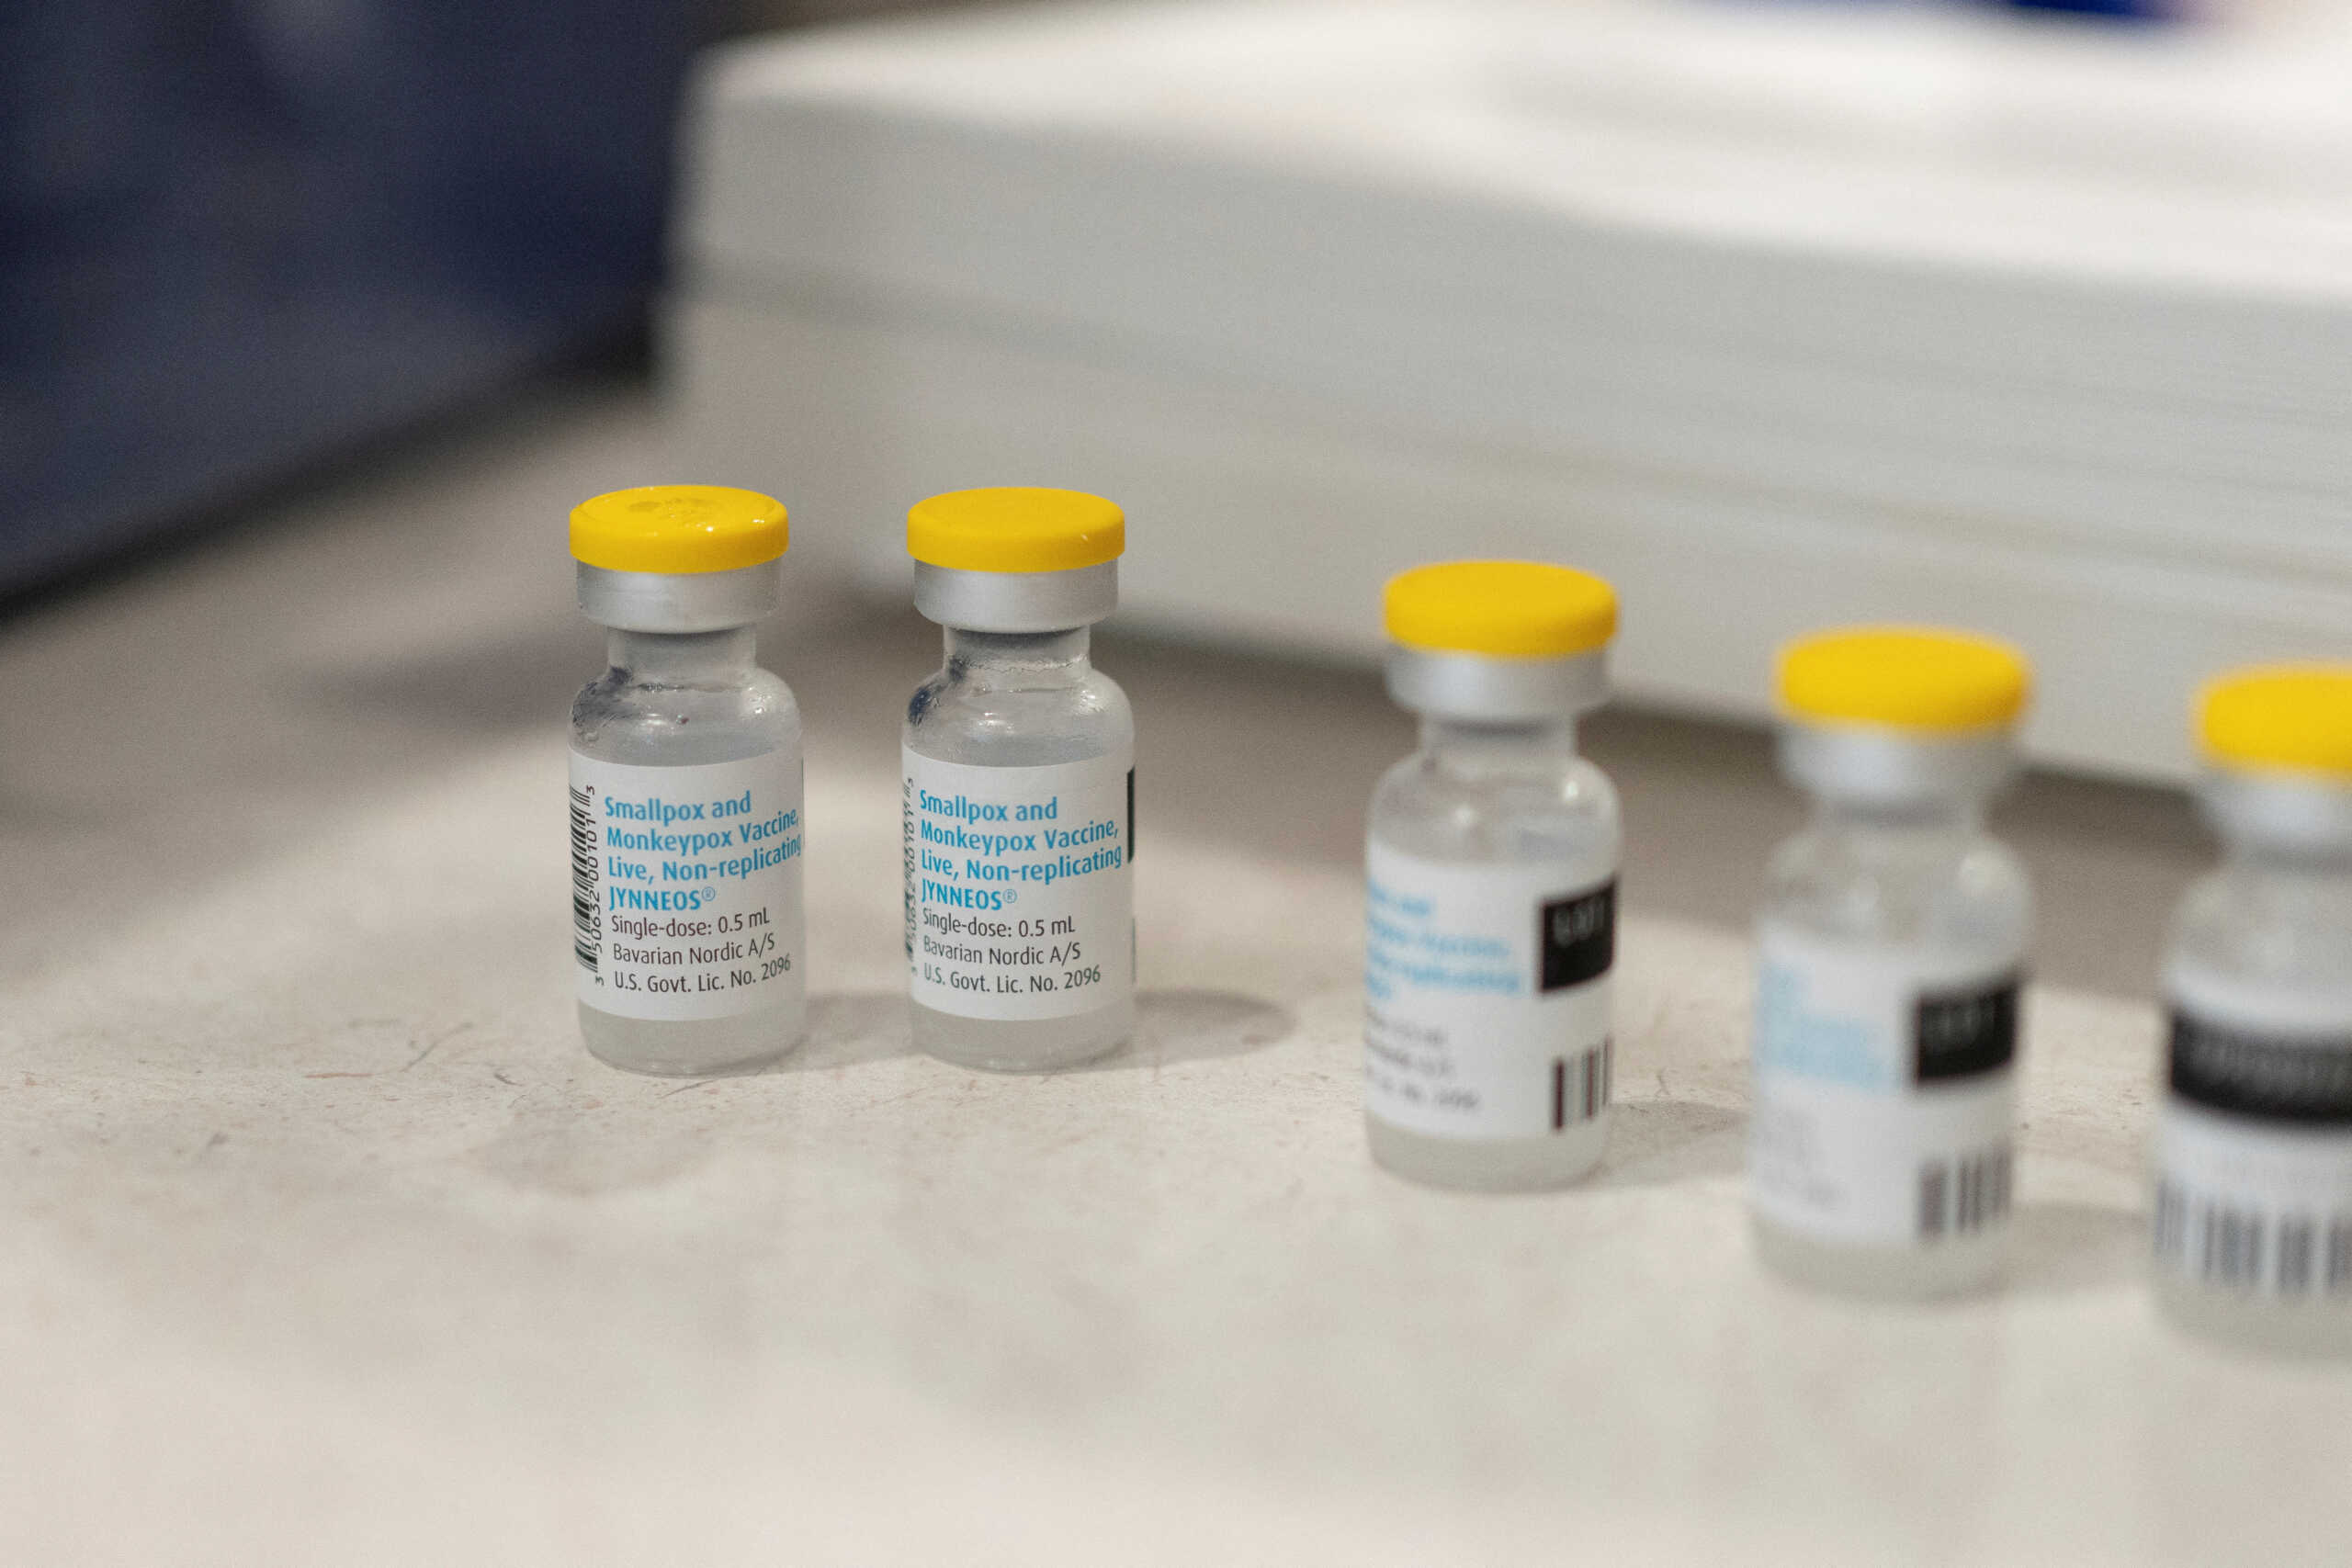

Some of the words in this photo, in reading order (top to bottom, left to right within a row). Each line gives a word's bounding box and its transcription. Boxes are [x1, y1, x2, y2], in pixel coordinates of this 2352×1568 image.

[586, 785, 594, 795] 3
[605, 796, 705, 827] Smallpox
[711, 790, 751, 818] and
[920, 790, 1009, 825] Smallpox
[1015, 796, 1057, 821] and
[586, 818, 599, 882] 00101
[606, 827, 733, 857] Monkeypox
[740, 808, 799, 843] Vaccine,
[921, 819, 1036, 857] Monkeypox
[1045, 819, 1118, 850] Vaccine,
[608, 856, 654, 885] Live,
[662, 834, 801, 881] Non-replicating
[922, 849, 959, 881] Live,
[967, 846, 1122, 886] Non-replicating
[589, 892, 602, 953] 50632
[611, 915, 712, 940] Single-dose:
[718, 913, 742, 934] 0.5
[749, 908, 770, 928] mL
[922, 908, 1012, 937] Single-dose:
[1018, 919, 1045, 937] 0.5
[1051, 916, 1075, 935] mL
[614, 943, 683, 964] Bavarian
[690, 943, 742, 964] Nordic
[749, 932, 775, 958] A/S
[923, 935, 982, 964] Bavarian
[989, 947, 1044, 964] Nordic
[1050, 942, 1080, 966] A/S
[615, 971, 641, 991] U.S.
[648, 976, 691, 992] Govt.
[698, 974, 724, 991] Lic.
[730, 969, 756, 987] No.
[761, 953, 791, 981] 2096
[924, 963, 944, 986] U.S.
[950, 971, 990, 992] Govt.
[997, 976, 1023, 993] Lic.
[1030, 976, 1057, 992] No.
[1064, 964, 1101, 989] 2096
